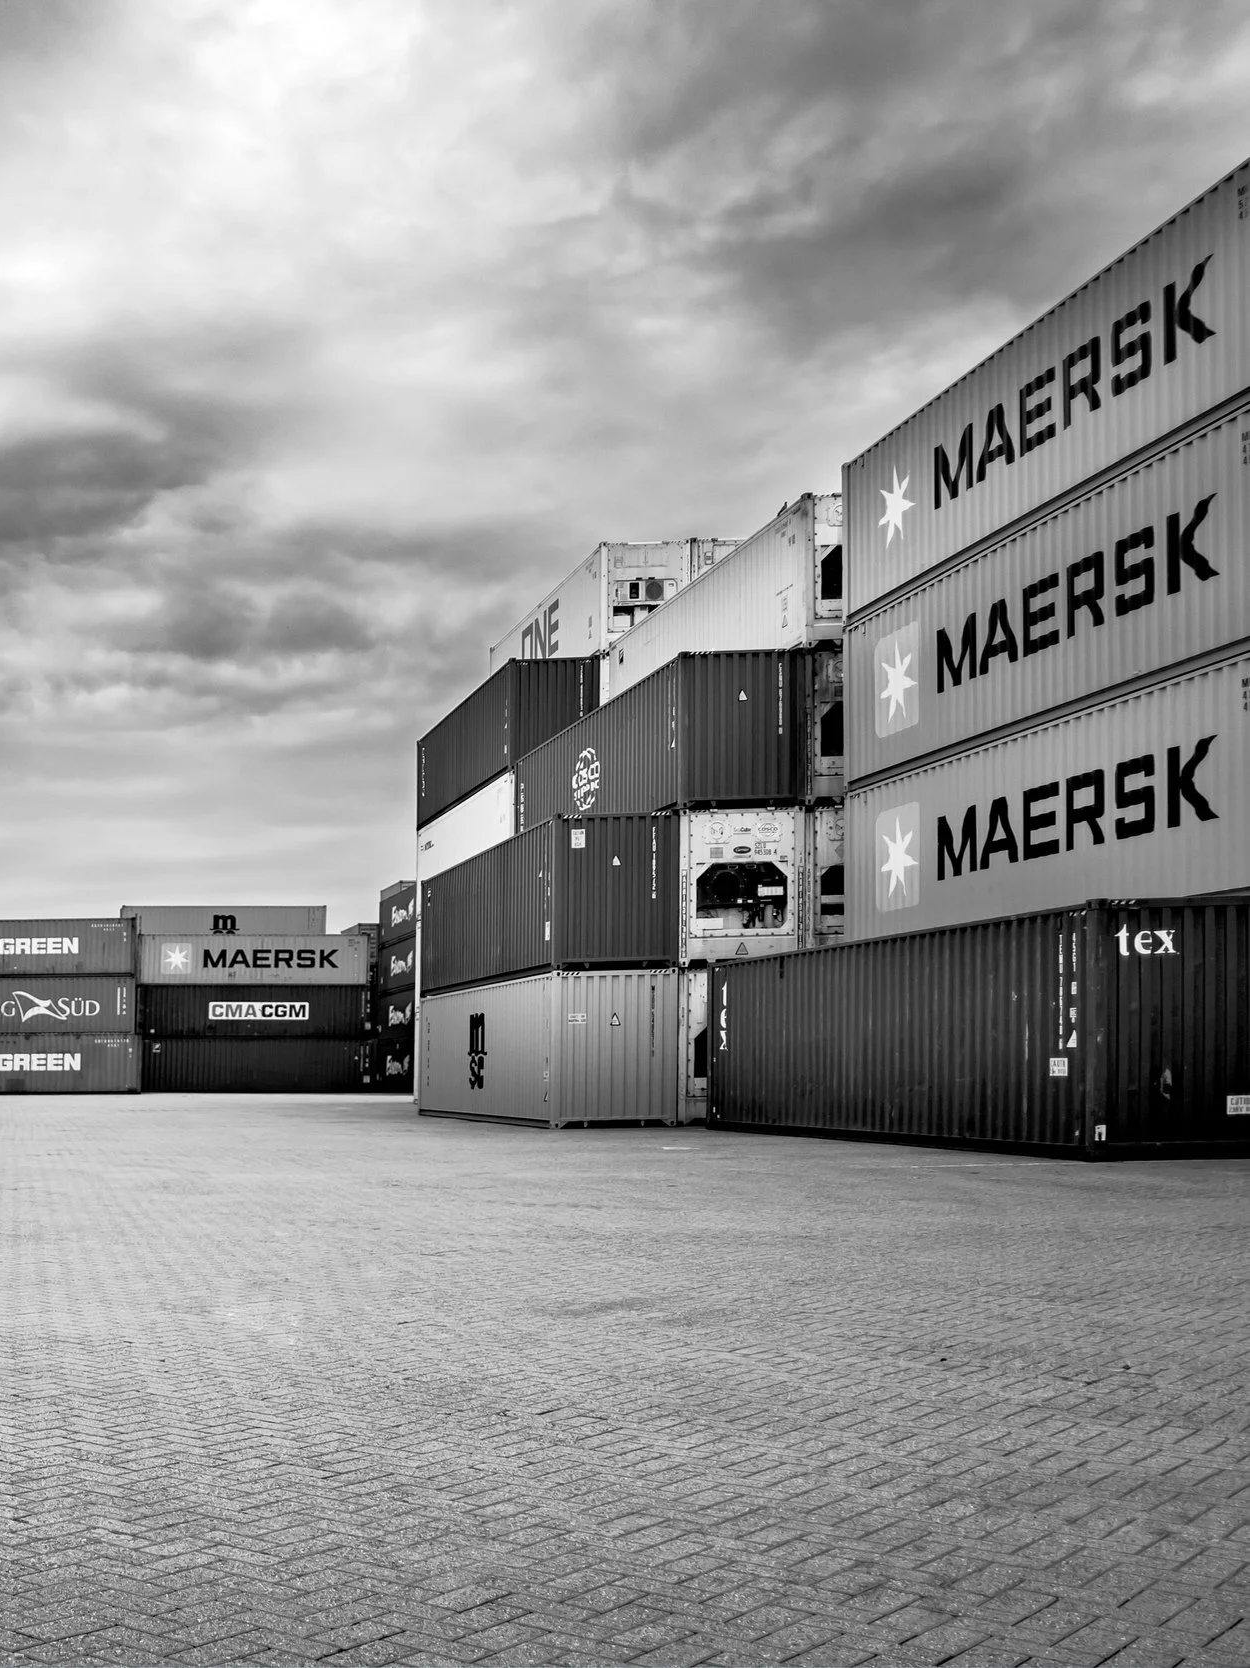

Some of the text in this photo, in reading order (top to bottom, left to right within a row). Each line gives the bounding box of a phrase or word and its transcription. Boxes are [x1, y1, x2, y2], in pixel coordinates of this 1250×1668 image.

[934, 253, 1216, 510] MAERSK
[937, 493, 1220, 694] MAERSK
[521, 599, 559, 659] ONE
[937, 734, 1220, 881] MAERSK
[203, 949, 340, 969] MAERSK
[1114, 924, 1177, 956] tex
[59, 997, 101, 1017] SÜD
[212, 1004, 306, 1018] CMA CGM
